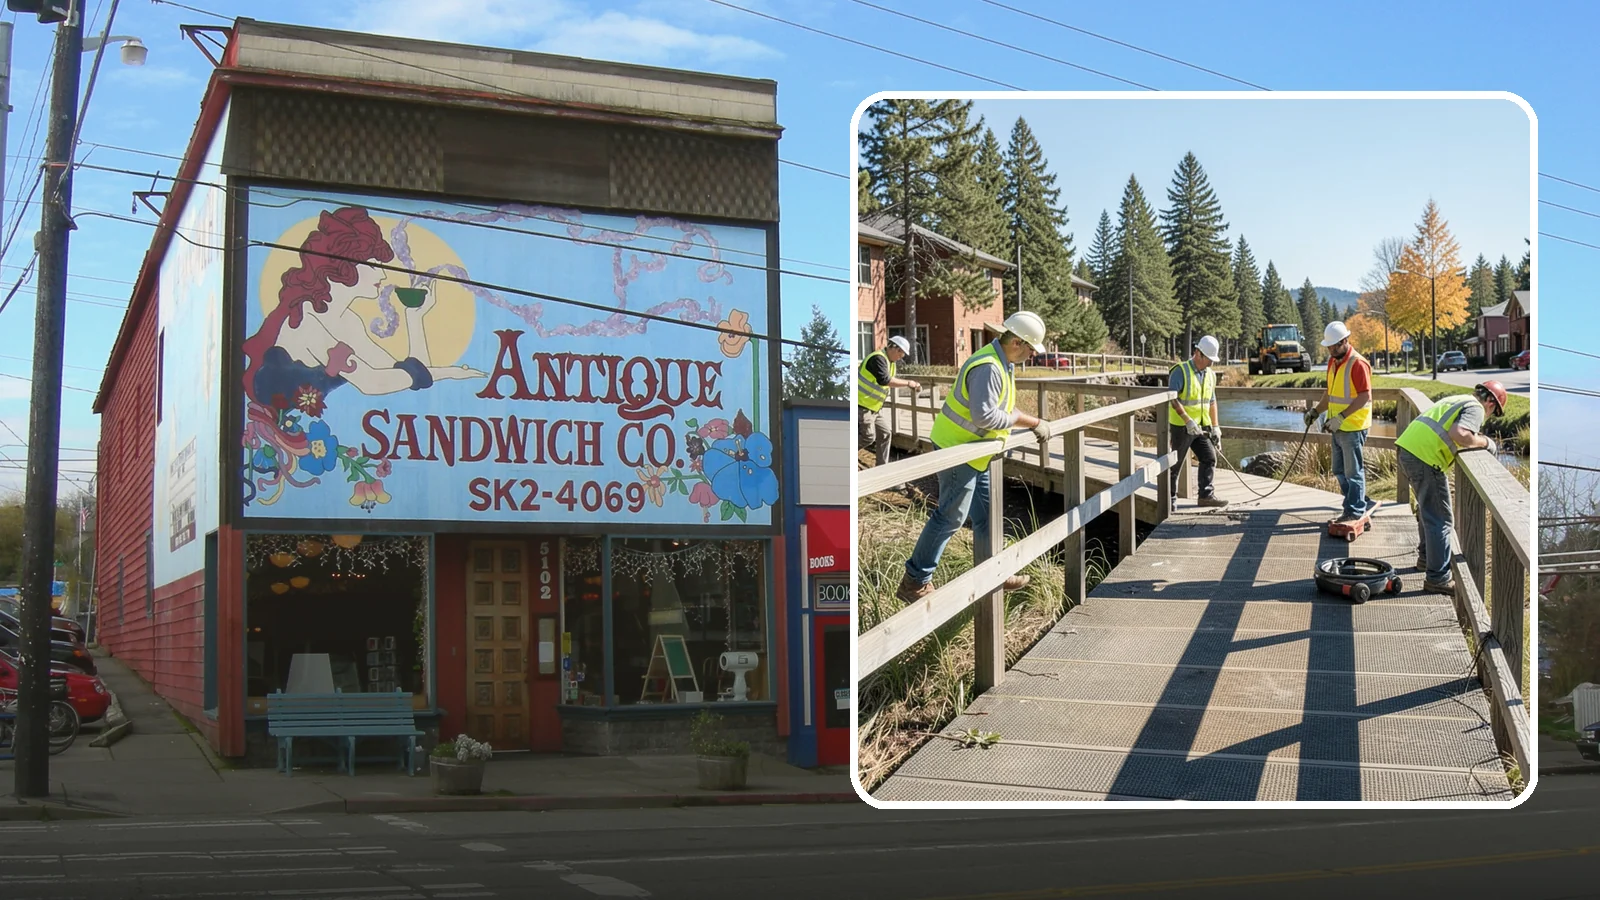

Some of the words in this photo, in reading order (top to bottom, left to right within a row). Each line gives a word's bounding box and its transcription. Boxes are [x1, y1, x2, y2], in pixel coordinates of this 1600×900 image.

[476, 329, 723, 420] ANTIQUE
[361, 408, 605, 468] SANDWICH
[617, 422, 685, 468] CO.
[469, 477, 646, 513] SK2-4069
[540, 542, 551, 599] 5102
[809, 555, 835, 569] BOOKS
